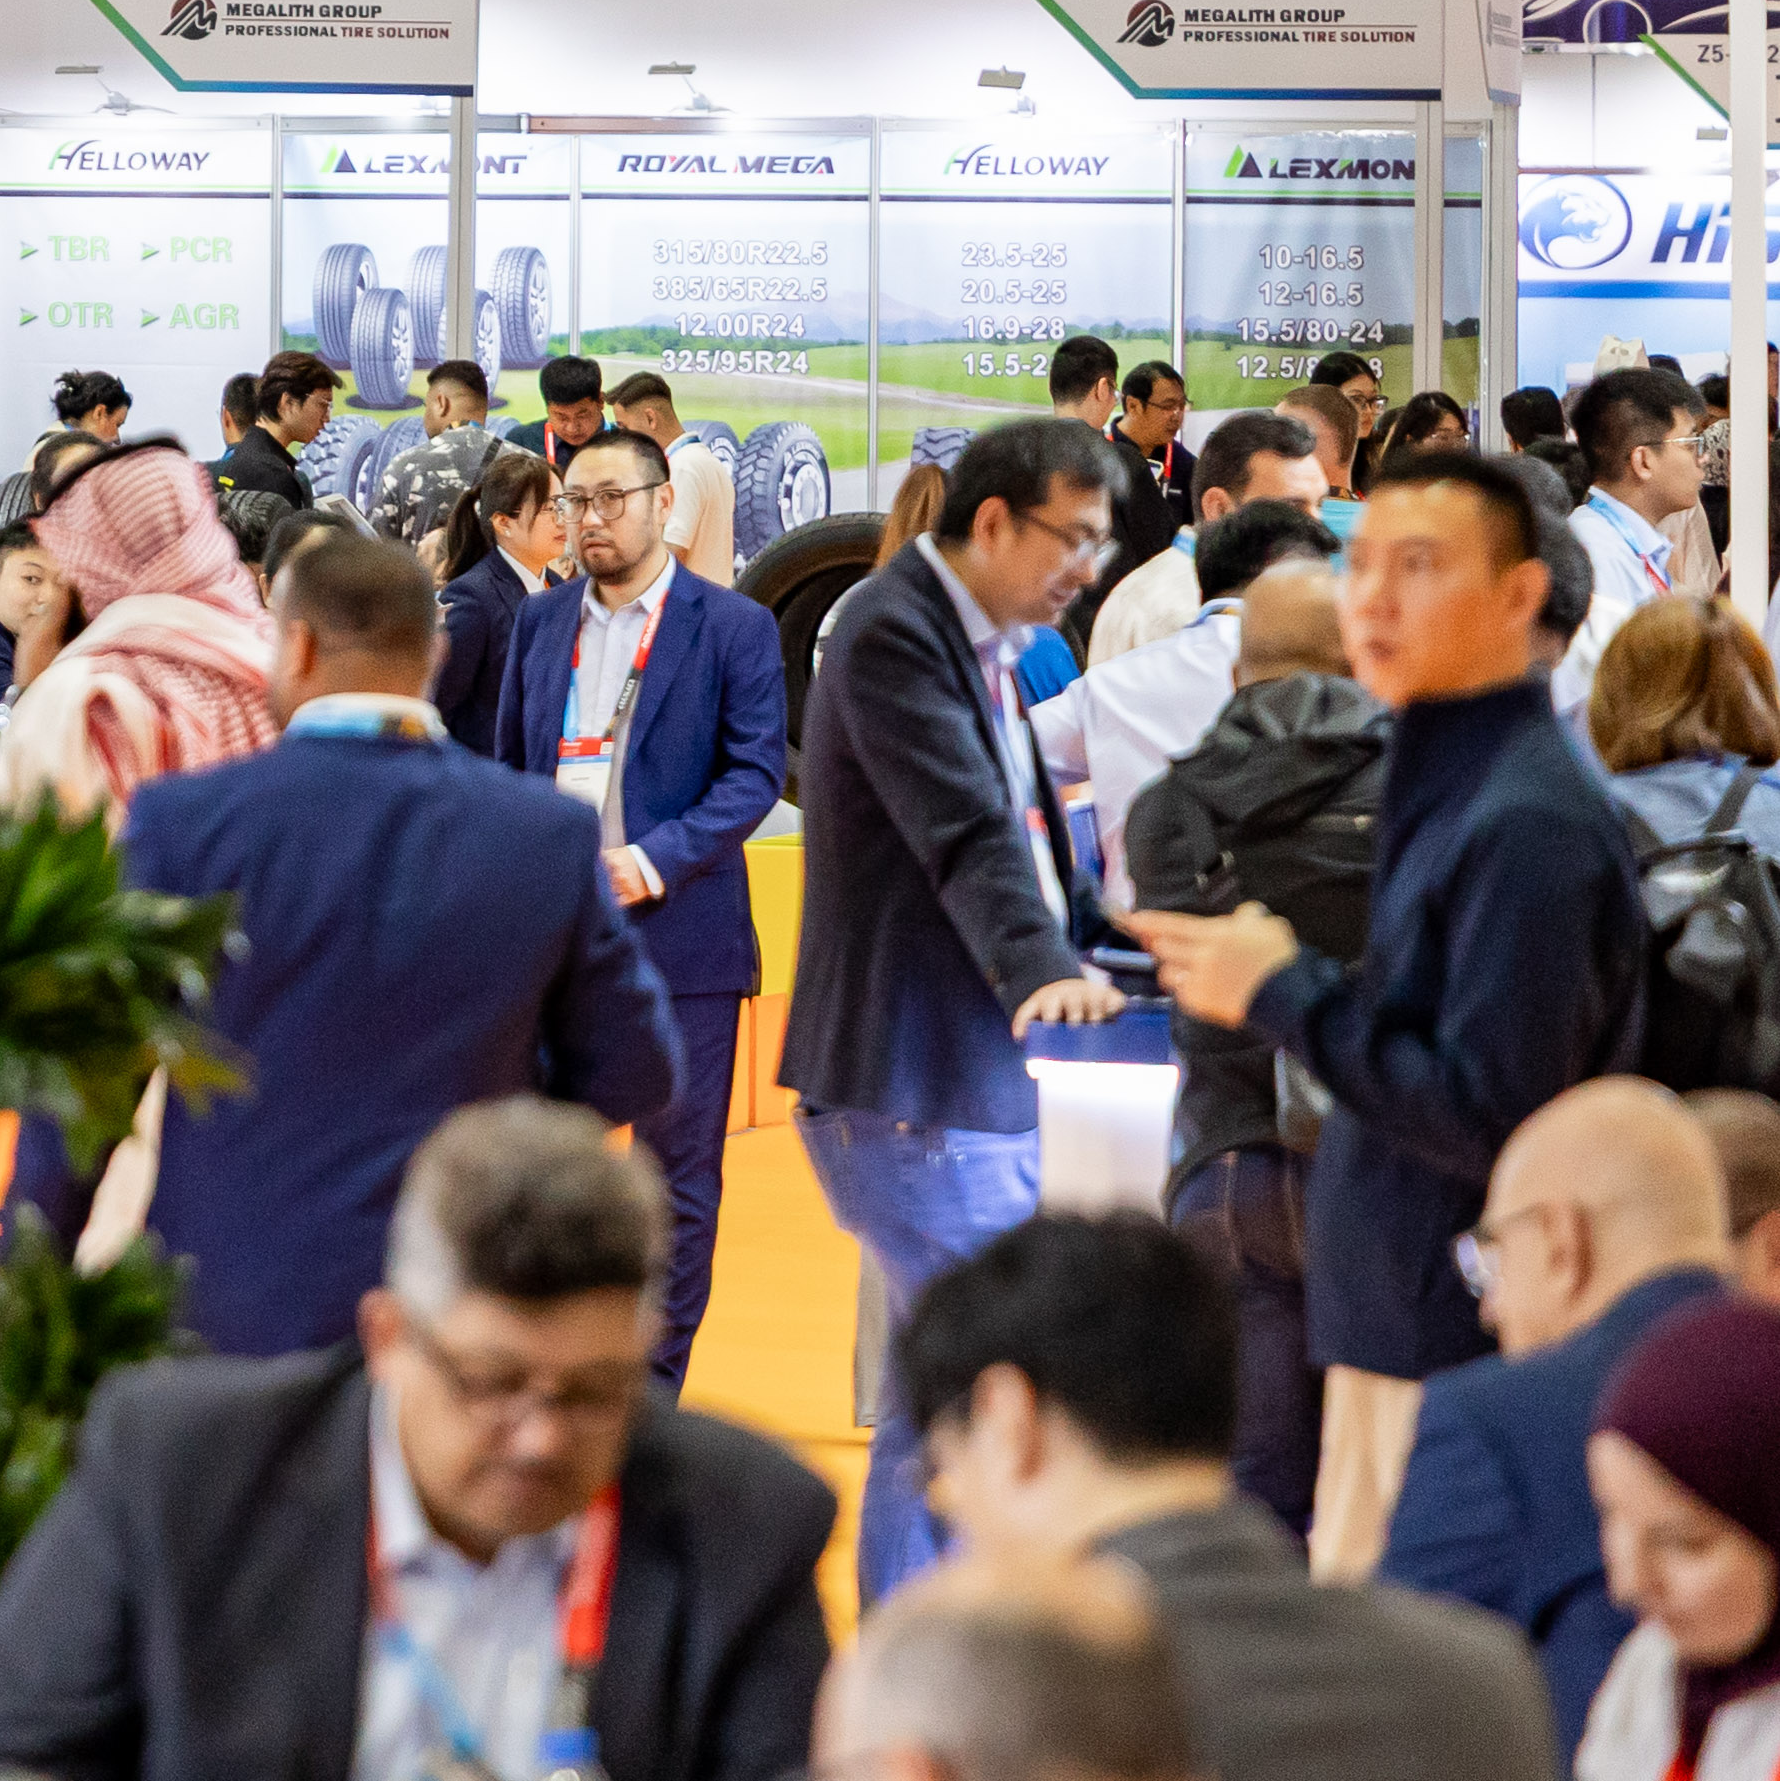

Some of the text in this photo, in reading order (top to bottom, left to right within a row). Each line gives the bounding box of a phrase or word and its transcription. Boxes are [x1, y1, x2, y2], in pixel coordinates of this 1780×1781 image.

[226, 3, 382, 19] MEGALITH GROUP
[1184, 9, 1345, 23] MEGALITH GROUP
[225, 24, 450, 39] PROFESSIONAL TIRE SOLUTION
[1183, 30, 1415, 43] PROFESSIONAL TIRE SOLUTION
[48, 140, 211, 172] HELLOWAY
[617, 153, 835, 176] ROYAL MEGA
[943, 143, 1110, 177] HELLOWAY
[48, 235, 232, 262] TBR PCR
[652, 239, 828, 266] 315/80R22.5
[961, 242, 1068, 268] 23.5-25
[1258, 243, 1364, 270] 10-16.5
[652, 276, 828, 303] 385/65R22.5
[961, 279, 1068, 305] 20.5-25
[1258, 280, 1364, 307] 12-16.5
[47, 302, 239, 329] OTR AGR
[674, 312, 806, 339] 12.00R24
[962, 315, 1066, 342] 16.9-28
[1236, 317, 1384, 343] 15.5/80-24
[660, 348, 809, 375] 325/95R24
[962, 352, 1049, 378] 15.5-2
